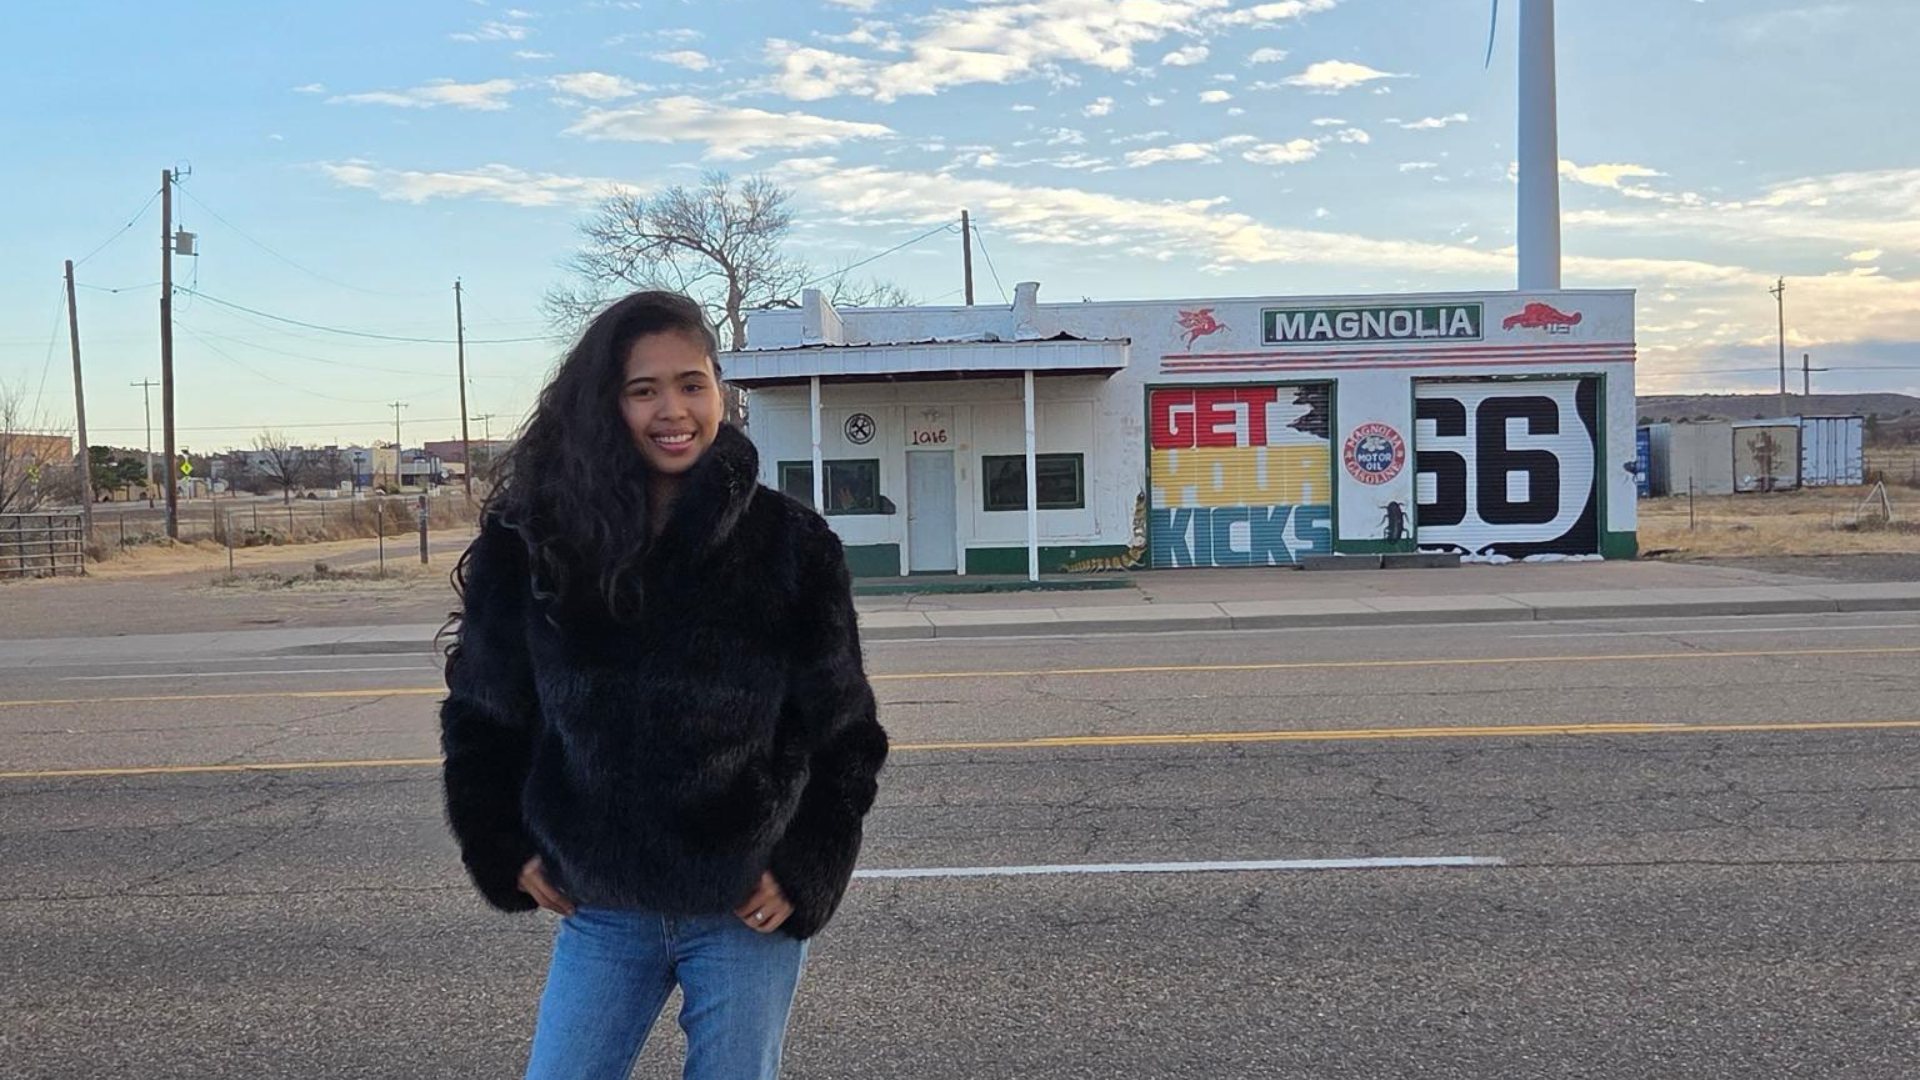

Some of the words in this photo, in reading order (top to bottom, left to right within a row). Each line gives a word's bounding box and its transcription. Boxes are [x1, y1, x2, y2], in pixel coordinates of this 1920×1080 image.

[1275, 308, 1473, 340] MAGNOLIA
[1151, 387, 1278, 449] GET
[1346, 424, 1402, 448] MAGNOLIA
[1358, 452, 1392, 462] MOTOR
[1365, 462, 1383, 471] OIL
[1151, 446, 1331, 508] YOUR
[1347, 461, 1402, 484] GASOLINE
[1151, 504, 1332, 568] KICKS
